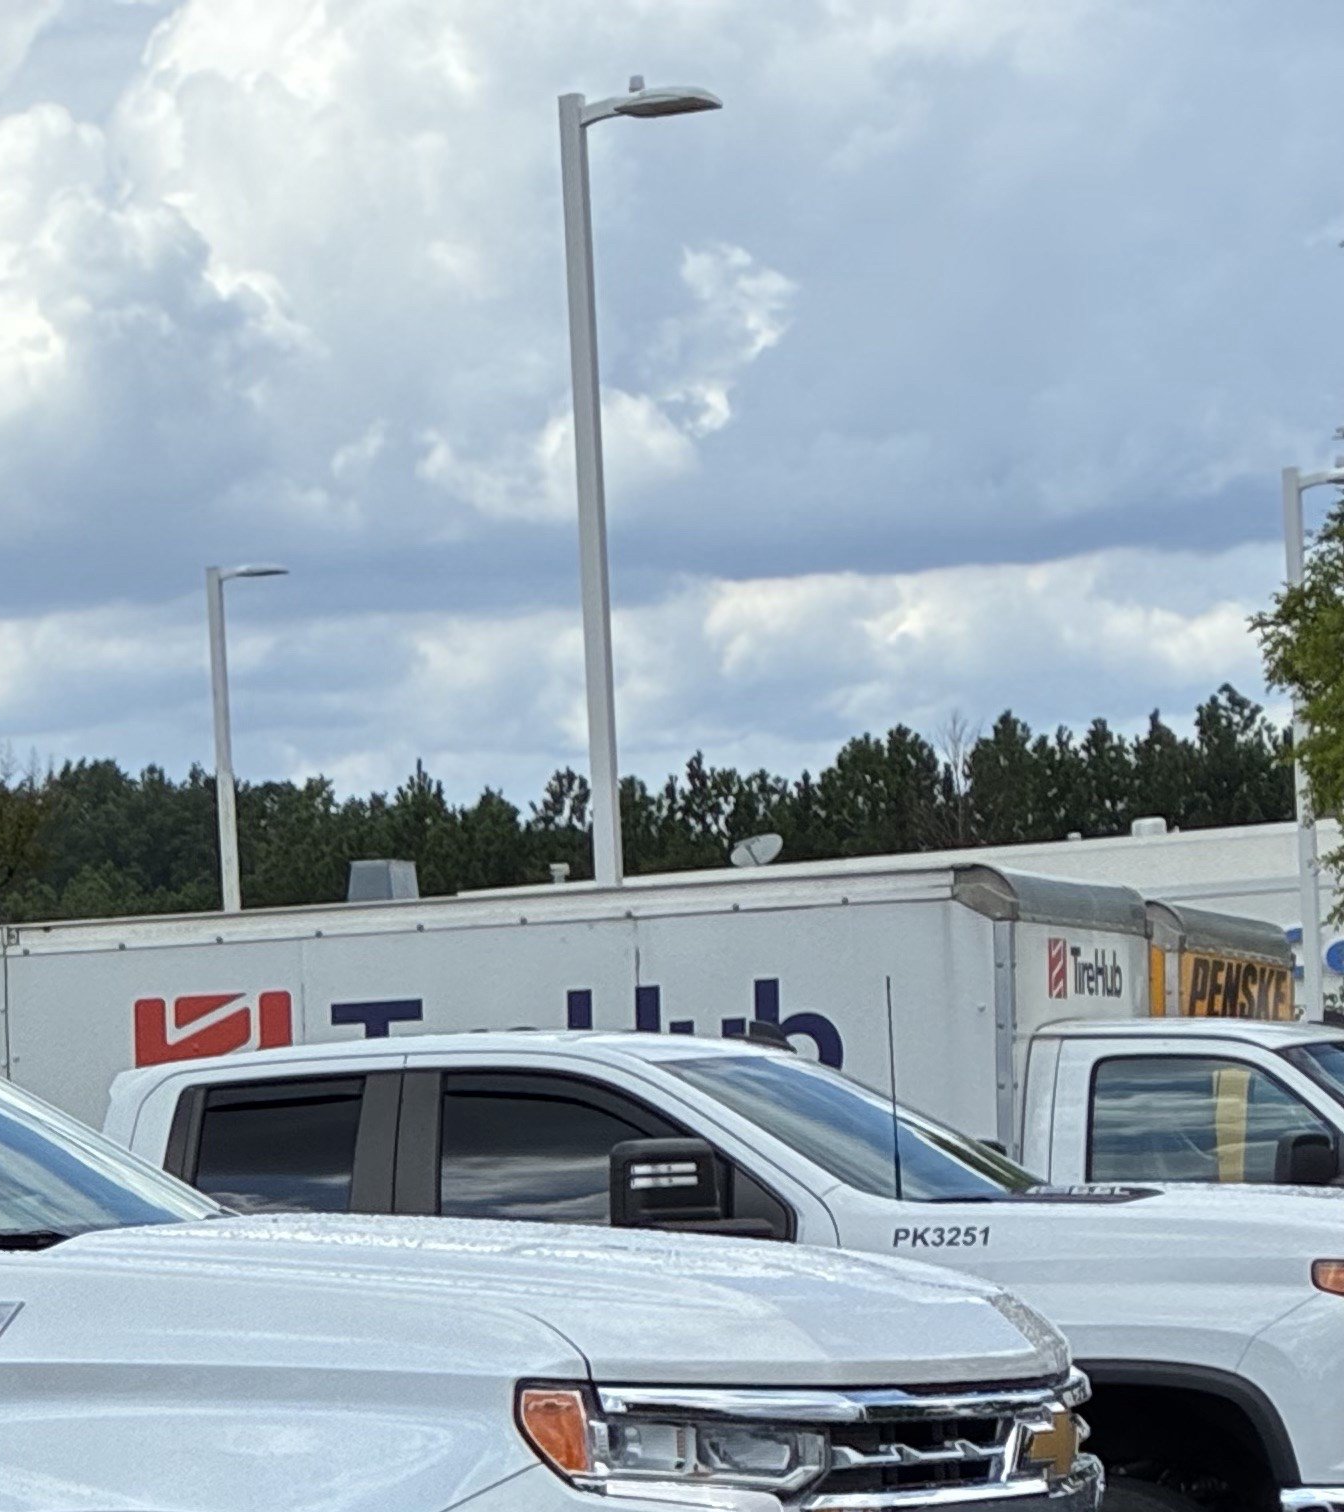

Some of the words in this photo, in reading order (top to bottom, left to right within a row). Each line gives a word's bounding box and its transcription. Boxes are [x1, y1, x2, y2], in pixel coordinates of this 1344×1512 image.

[1070, 945, 1123, 998] TireHub
[1188, 957, 1288, 1020] PENSKE
[892, 1225, 991, 1248] PK3251
